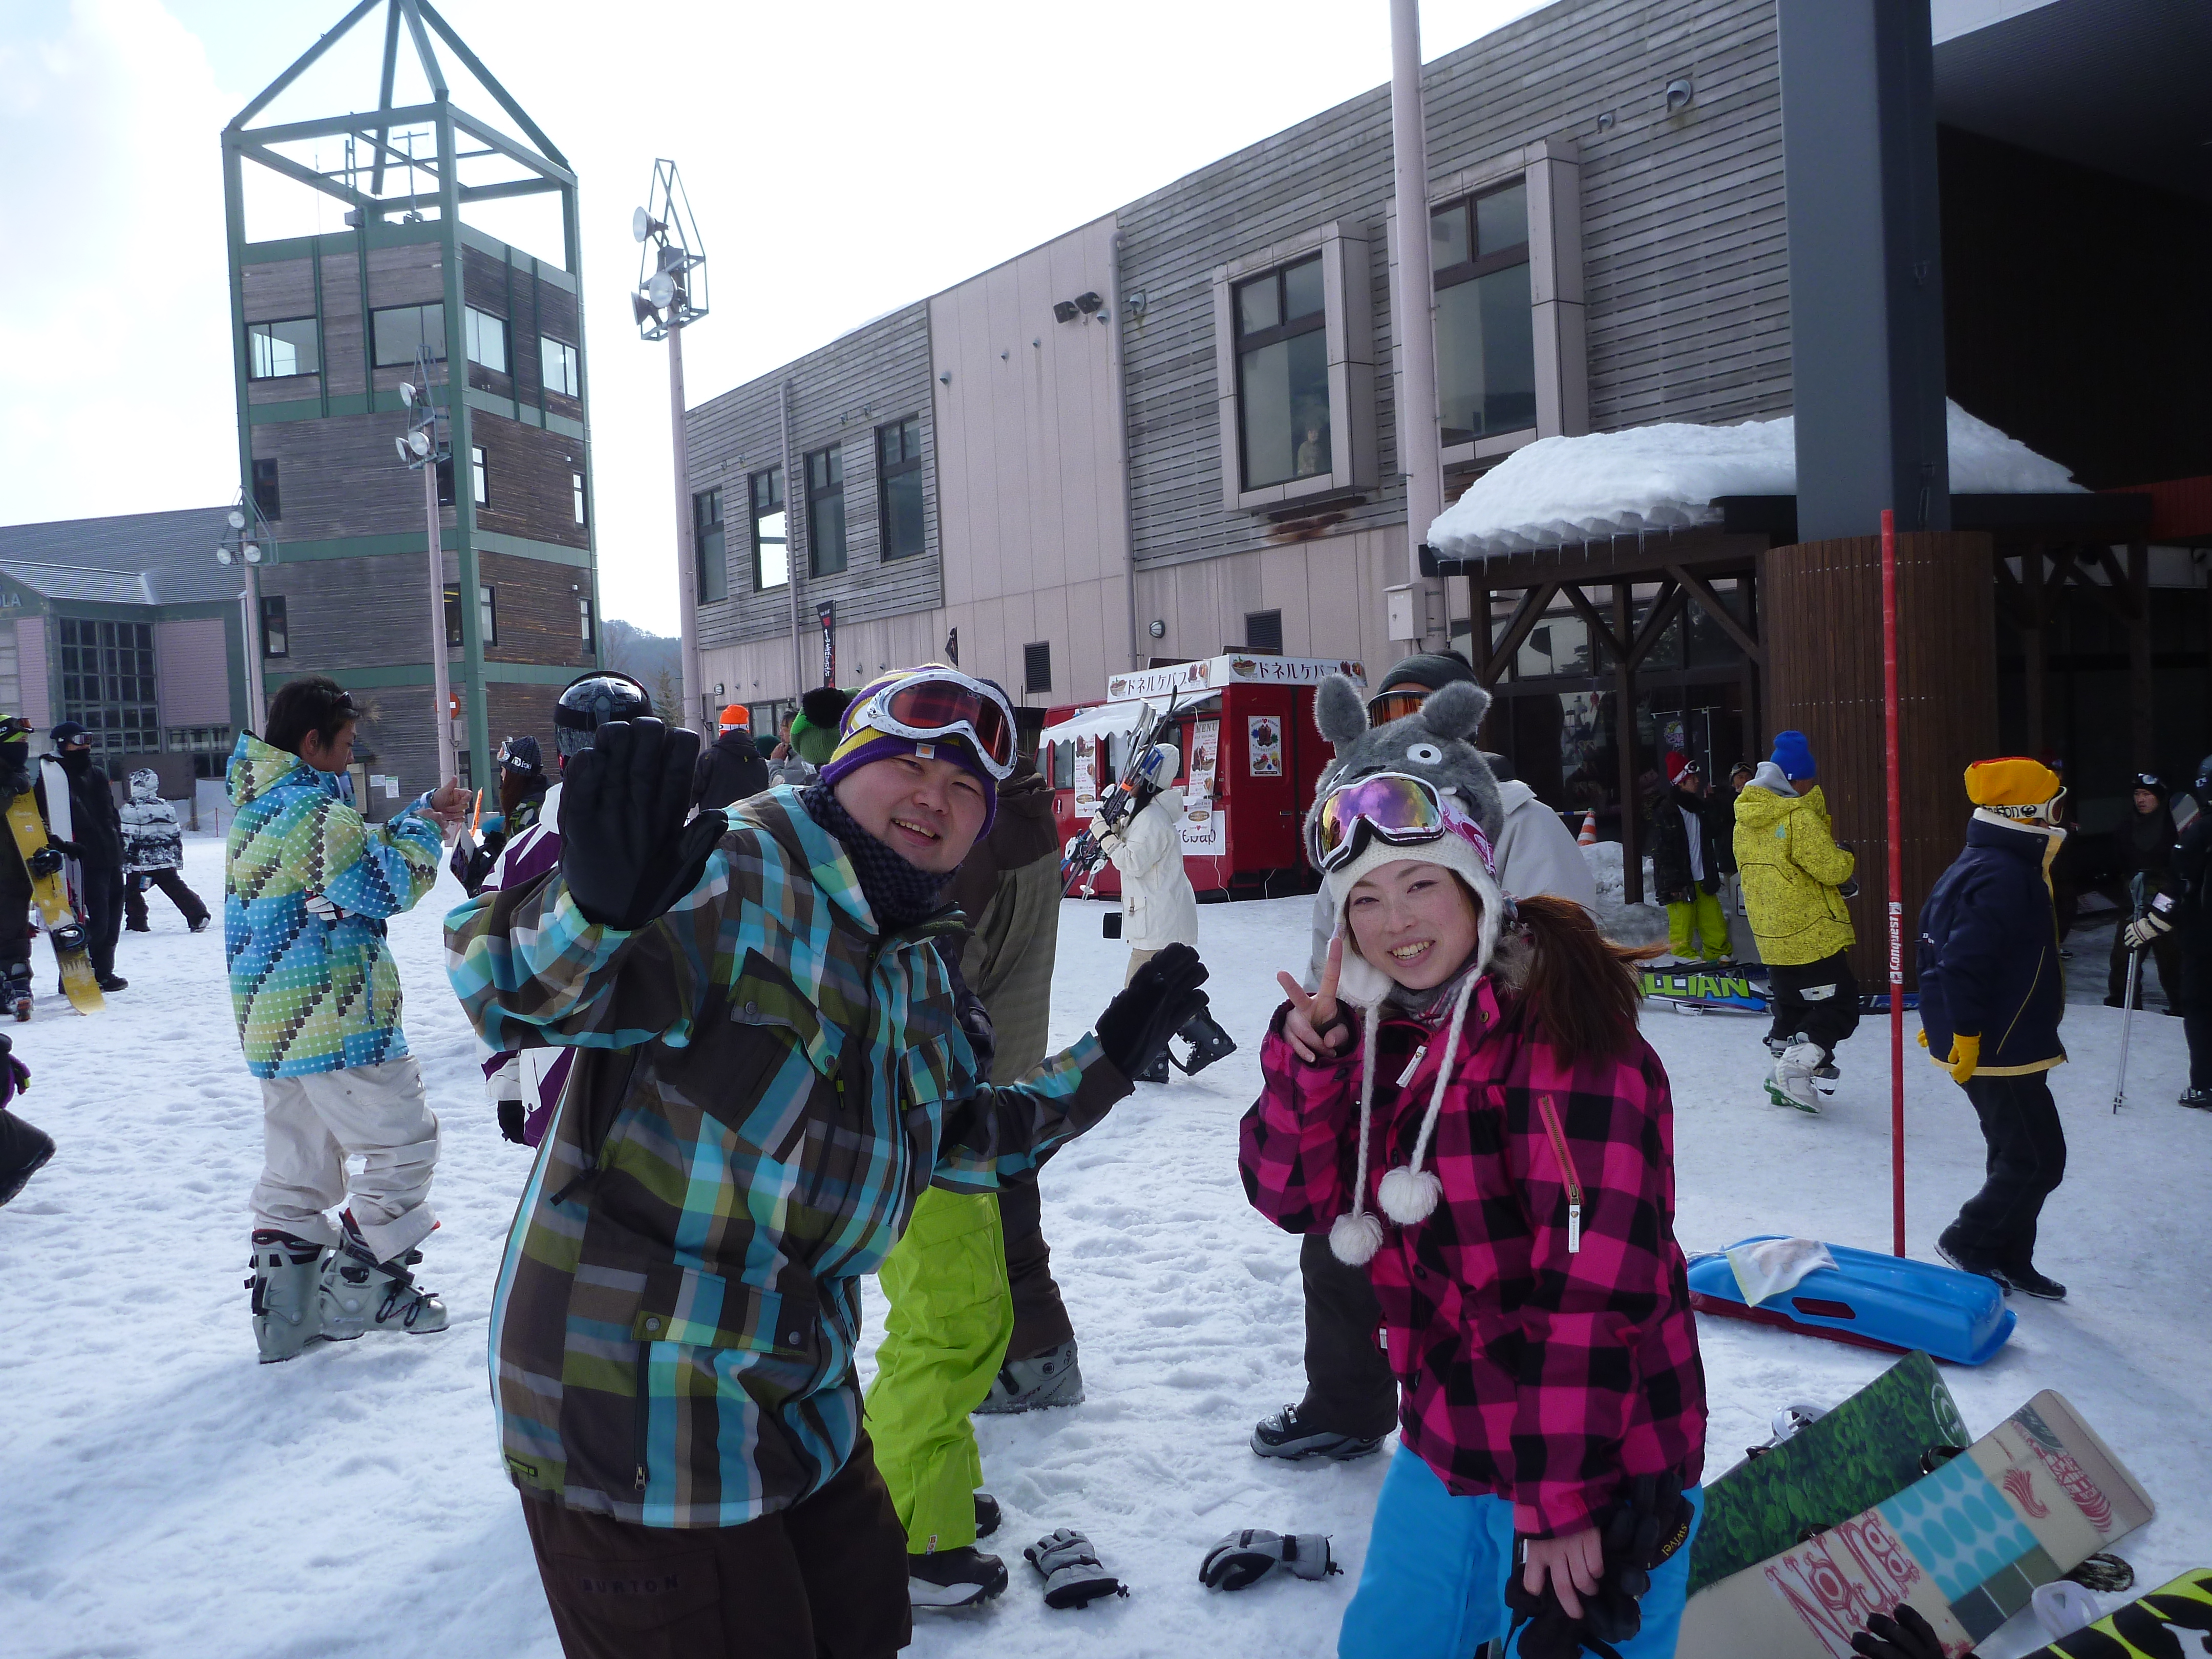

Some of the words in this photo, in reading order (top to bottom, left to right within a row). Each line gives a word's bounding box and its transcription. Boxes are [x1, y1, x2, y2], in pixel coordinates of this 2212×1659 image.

[0, 593, 22, 607] LA
[1889, 916, 1901, 971] Conquest
[1661, 1523, 1687, 1557] swivel
[581, 1573, 678, 1593] BURTON
